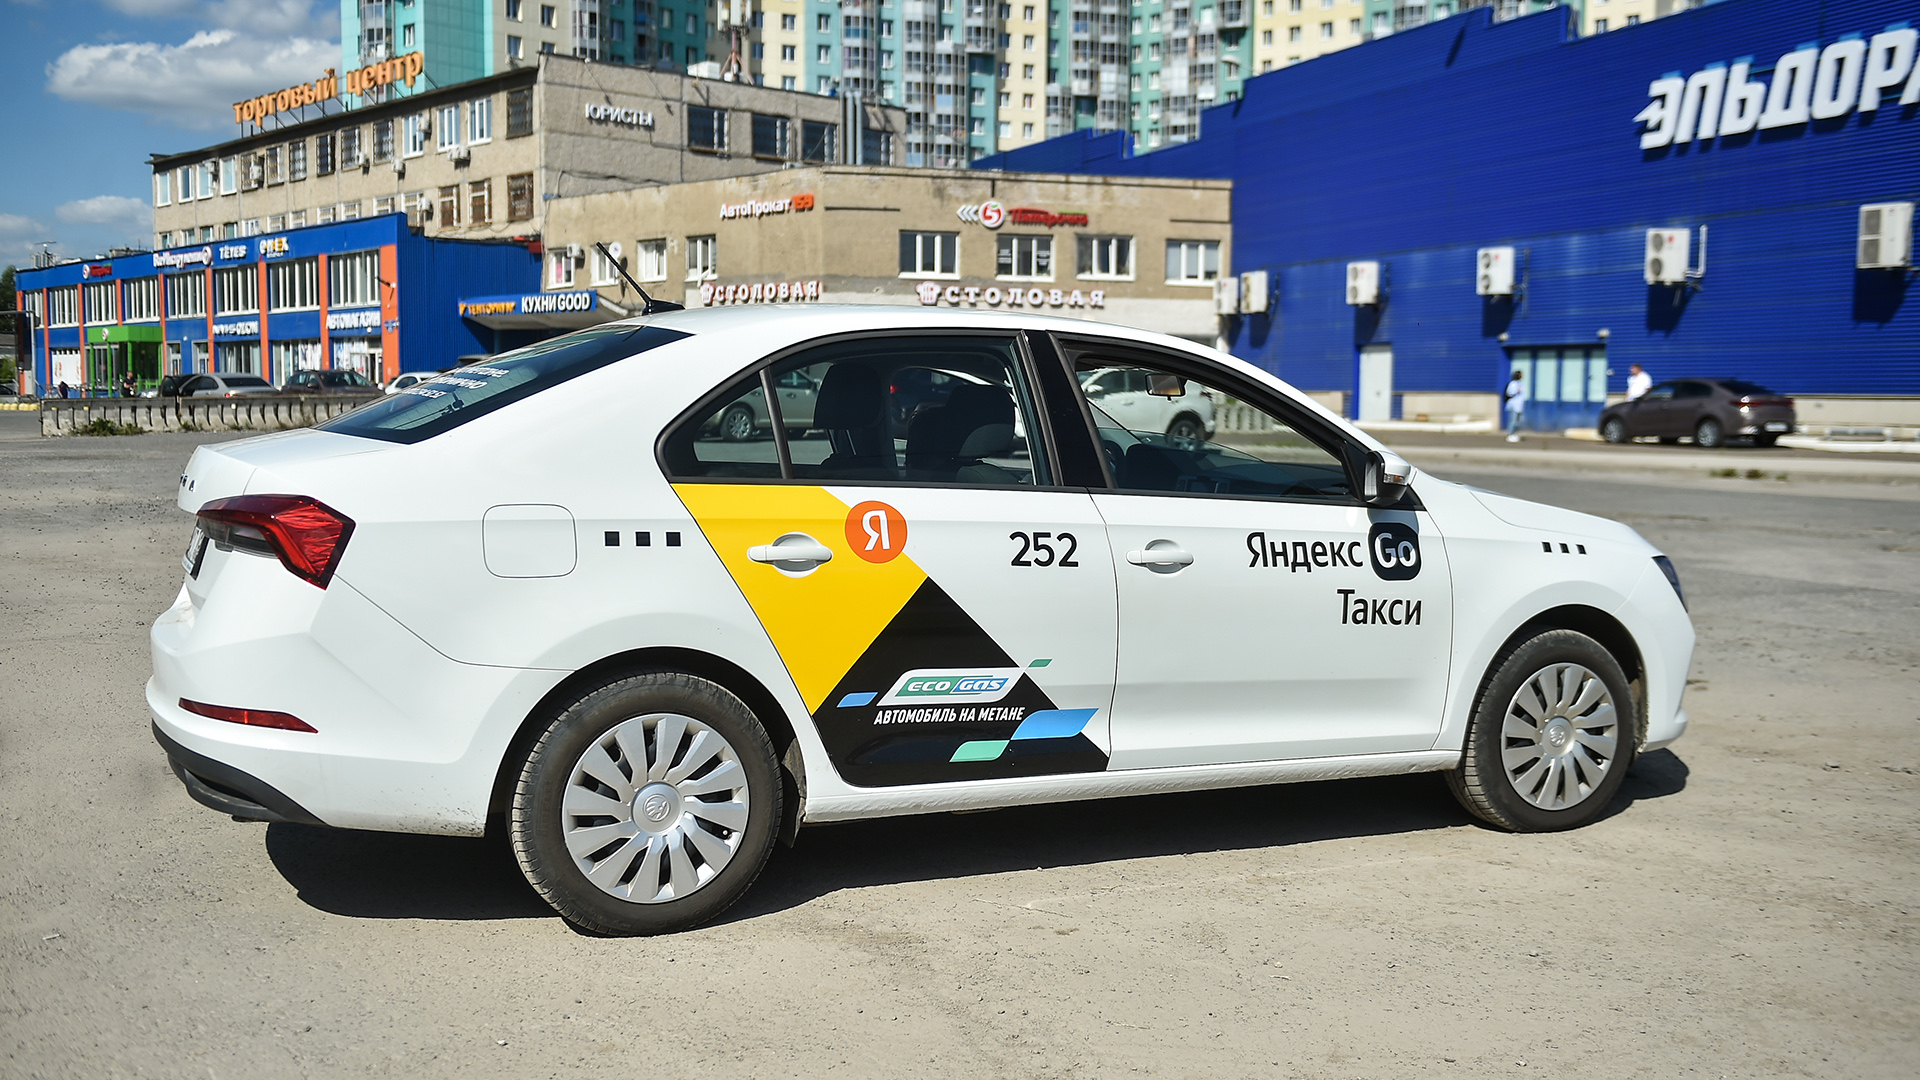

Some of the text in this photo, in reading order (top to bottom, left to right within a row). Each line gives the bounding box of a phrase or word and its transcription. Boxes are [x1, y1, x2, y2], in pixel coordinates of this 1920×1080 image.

[233, 51, 424, 127] торговый центр
[585, 103, 653, 126] ЮРИСТЫ
[720, 199, 791, 218] АвтоПрокат
[521, 292, 590, 313] КУХНИ GOOD
[715, 281, 820, 301] СТОЛОВАЯ
[945, 286, 1105, 307] СТОЛОВАЯ
[862, 509, 891, 551] Я
[1009, 531, 1079, 567] 252
[1246, 531, 1417, 573] Яндекс Go
[1336, 588, 1422, 626] Такси
[874, 706, 1025, 725] АВТОМОБИЛЬ НА МЕТАНЕ
